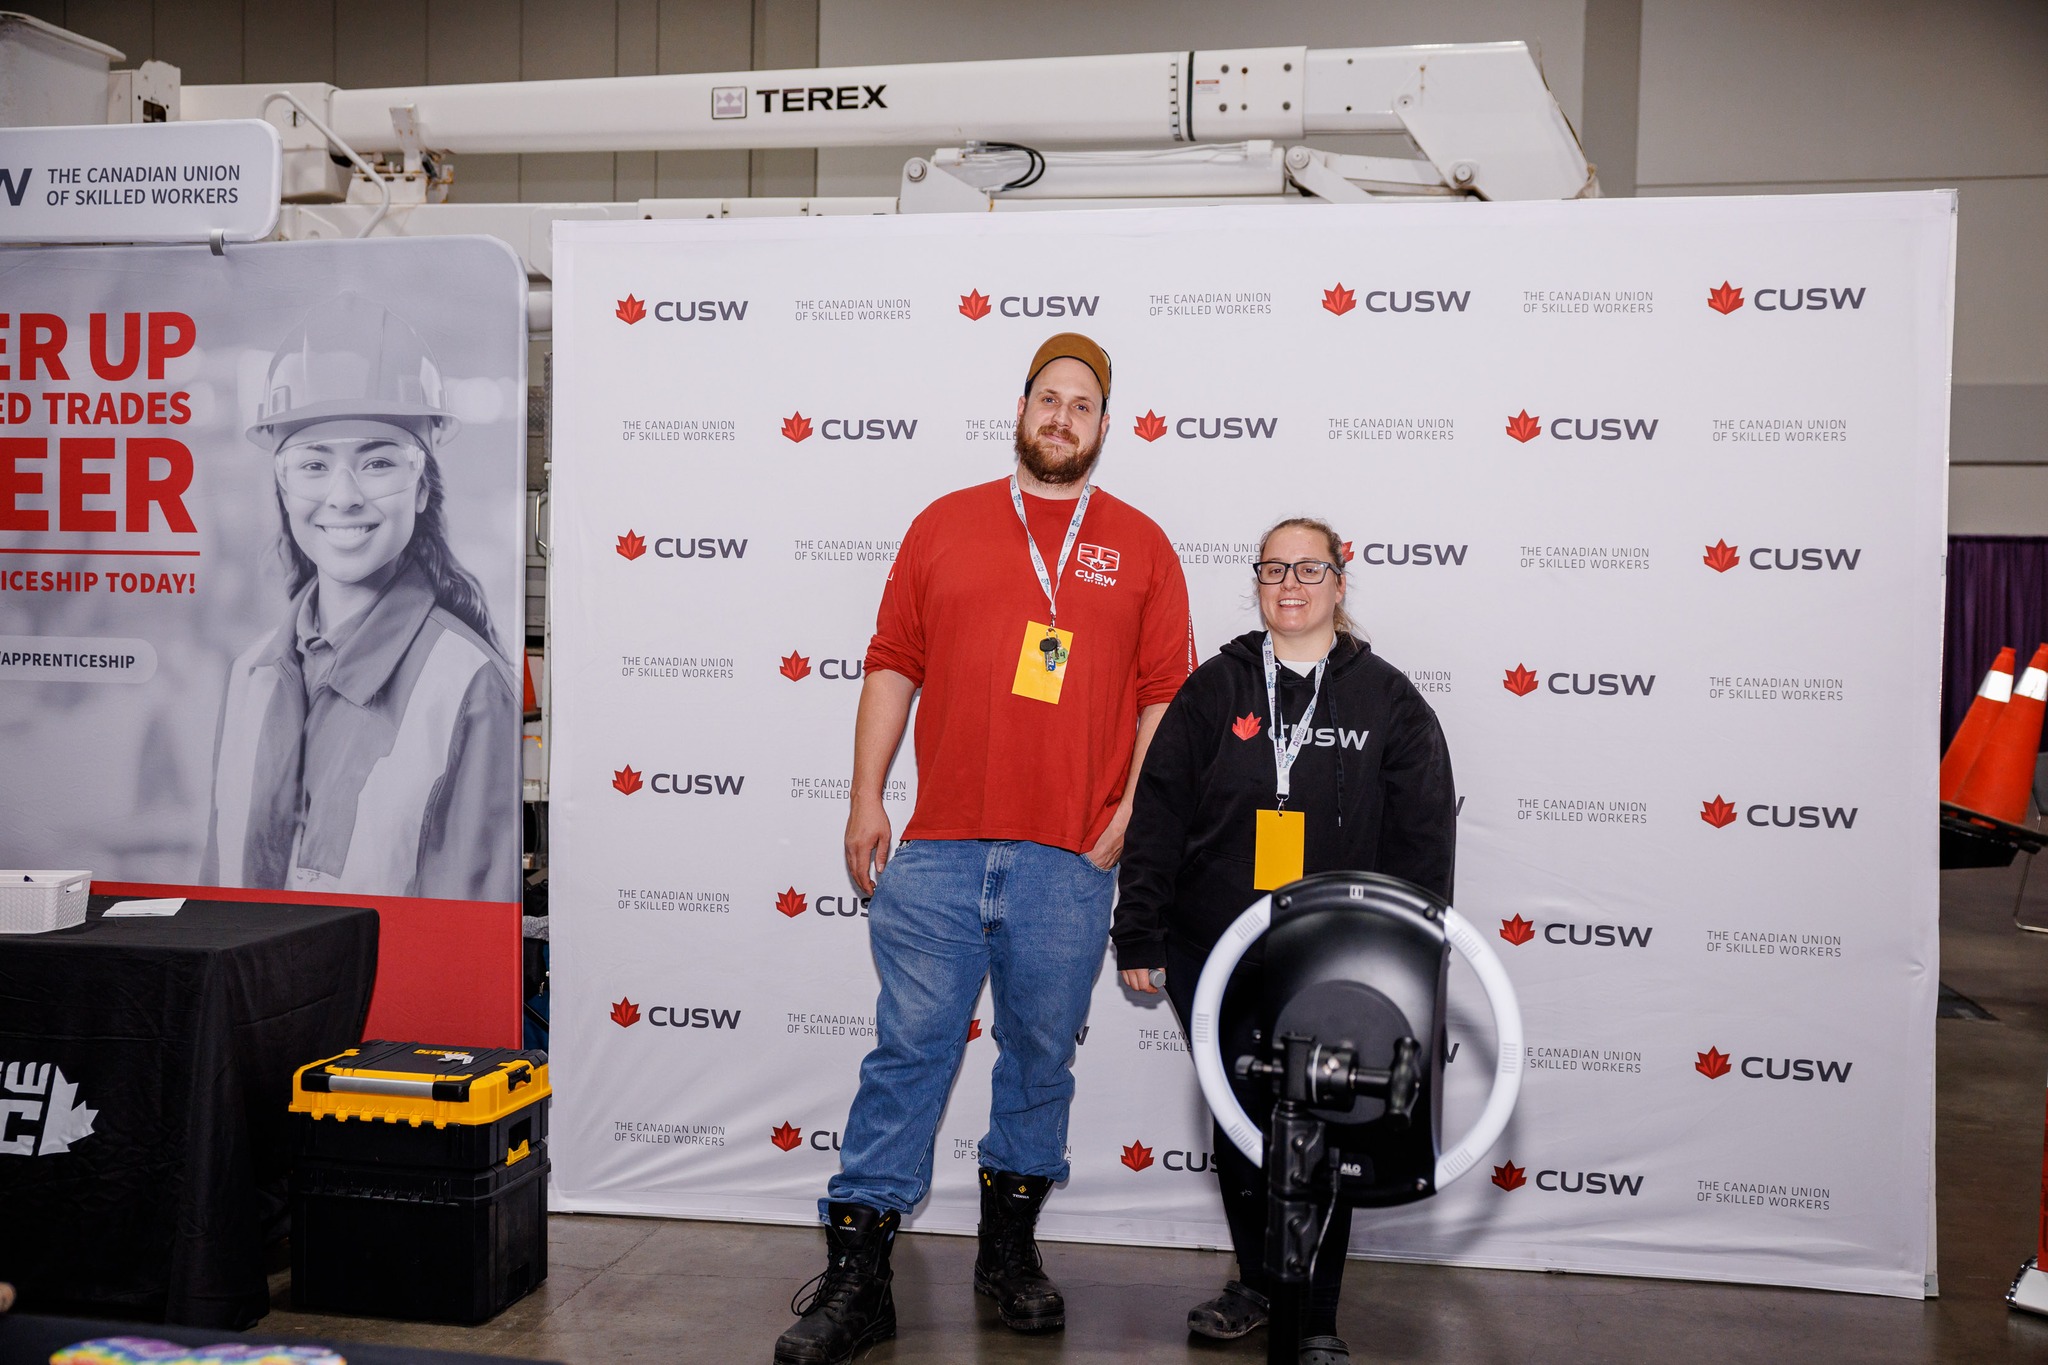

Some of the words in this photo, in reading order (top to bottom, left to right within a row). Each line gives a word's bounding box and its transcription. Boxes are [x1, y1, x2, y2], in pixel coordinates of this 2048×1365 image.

[756, 84, 888, 113] TEREX
[48, 168, 81, 184] THE
[87, 166, 177, 183] CANADIAN
[183, 165, 240, 181] UNION
[47, 190, 70, 206] OF
[75, 189, 146, 205] SKILLED
[151, 187, 239, 204] WORKERS
[1150, 295, 1170, 304] THE
[1174, 294, 1231, 304] CANADIAN
[1236, 293, 1270, 302] UNION
[1366, 291, 1470, 312] CUSW
[1524, 291, 1544, 301] THE
[1549, 292, 1610, 301] CANADIAN
[1616, 292, 1652, 301] UNION
[1755, 288, 1866, 311] CUSW
[795, 300, 814, 309] THE
[818, 300, 872, 309] CANADIAN
[877, 299, 910, 308] UNION
[1000, 296, 1099, 317] CUSW
[1150, 306, 1163, 316] OF
[1166, 305, 1211, 315] SKILLED
[1215, 304, 1271, 314] WORKERS
[1524, 303, 1539, 313] OF
[1542, 303, 1588, 313] SKILLED
[1593, 303, 1653, 313] WORKERS
[655, 301, 748, 321] CUSW
[795, 312, 808, 321] OF
[812, 311, 854, 320] SKILLED
[858, 310, 910, 320] WORKERS
[89, 312, 196, 381] UP
[42, 391, 191, 425] TRADES
[623, 421, 642, 430] THE
[645, 421, 698, 430] CANADIAN
[702, 421, 734, 430] UNION
[822, 419, 918, 440] CUSW
[966, 420, 985, 429] THE
[989, 420, 1017, 429] CANA
[1177, 418, 1278, 439] CUSW
[1329, 418, 1349, 428] THE
[1354, 418, 1412, 428] CANADIAN
[1418, 419, 1453, 428] UNION
[1551, 418, 1658, 440] CUSW
[1713, 420, 1734, 429] THE
[1740, 420, 1802, 430] CANADIAN
[1808, 420, 1846, 429] UNION
[623, 432, 635, 440] OF
[638, 432, 680, 440] SKILLED
[683, 432, 735, 440] WORKERS
[966, 431, 979, 440] OF
[983, 431, 1017, 440] SKILLE
[1329, 430, 1342, 439] OF
[1346, 430, 1392, 439] SKILLED
[1396, 430, 1454, 440] WORKERS
[1713, 432, 1727, 441] OF
[1732, 432, 1780, 441] SKILLED
[1785, 432, 1846, 441] WORKERS
[655, 538, 748, 558] CUSW
[795, 540, 813, 549] THE
[817, 540, 872, 549] CANADIAN
[876, 541, 901, 550] UNIO
[1234, 544, 1261, 553] UNIO
[795, 551, 807, 560] OF
[811, 552, 853, 560] SKILLED
[857, 552, 896, 561] WORKE
[1364, 544, 1468, 565] CUSW
[1520, 546, 1541, 556] THE
[1545, 547, 1607, 557] CANADIAN
[1612, 548, 1649, 558] UNION
[1521, 558, 1534, 567] OF
[1538, 558, 1585, 568] SKILLED
[1590, 560, 1649, 569] WORKERS
[1750, 548, 1861, 570] CUSW
[106, 573, 195, 594] TODAY!
[1075, 570, 1117, 586] CUSW
[0, 652, 135, 668] APPRENTICESHIP
[622, 656, 640, 666] THE
[644, 657, 697, 666] CANADIAN
[701, 658, 733, 667] UNION
[622, 667, 634, 676] OF
[637, 668, 678, 677] SKILLED
[682, 669, 733, 678] WORKERS
[820, 659, 862, 680] CU
[1415, 671, 1451, 681] UNION
[1413, 682, 1452, 692] RKERS
[1548, 673, 1655, 695] CUSW
[1710, 677, 1731, 687] THE
[1736, 678, 1799, 688] CANADIAN
[1804, 679, 1842, 688] UNION
[1710, 689, 1724, 698] OF
[1729, 689, 1777, 699] SKILLED
[1782, 690, 1843, 700] WORKERS
[651, 774, 744, 795] CUSW
[791, 778, 810, 787] THE
[814, 779, 850, 788] CANAD
[791, 789, 804, 798] OF
[807, 789, 850, 799] SKILLED
[1518, 799, 1538, 808] THE
[1544, 800, 1604, 810] CANADIAN
[1610, 802, 1646, 812] UNION
[1518, 810, 1532, 820] OF
[1536, 811, 1583, 821] SKILLED
[1587, 813, 1646, 824] WORKERS
[1747, 805, 1858, 829] CUSW
[618, 889, 636, 898] THE
[640, 890, 693, 900] CANADIAN
[697, 892, 729, 902] UNION
[618, 900, 630, 909] OF
[633, 901, 674, 910] SKILLED
[678, 902, 729, 913] WORKERS
[1545, 923, 1652, 947] CUSW
[1707, 930, 1729, 940] THE
[1734, 932, 1796, 943] CANADIAN
[1802, 935, 1840, 945] UNION
[1707, 942, 1722, 951] OF
[1726, 943, 1774, 954] SKILLED
[1779, 946, 1841, 957] WORKERS
[649, 1007, 741, 1029] CUSW
[787, 1013, 806, 1022] THE
[810, 1014, 864, 1025] CANADIAN
[787, 1024, 800, 1033] OF
[803, 1025, 845, 1035] SKILLED
[849, 1027, 879, 1037] WORK
[1139, 1029, 1159, 1039] THE
[1139, 1040, 1152, 1050] OF
[1537, 1047, 1599, 1059] CANADIAN
[1603, 1051, 1641, 1062] UNION
[1530, 1058, 1577, 1070] SKILLED
[1581, 1061, 1641, 1073] WORKERS
[1741, 1057, 1852, 1083] CUSW
[615, 1122, 633, 1131] THE
[637, 1123, 688, 1134] CANADIAN
[693, 1126, 725, 1135] UNION
[615, 1132, 627, 1141] OF
[630, 1132, 670, 1143] SKILLED
[674, 1135, 724, 1146] WORKERS
[954, 1138, 973, 1149] THE
[954, 1150, 967, 1159] OF
[1340, 1162, 1362, 1174] ALO
[1536, 1170, 1644, 1196] CUSW
[1698, 1180, 1719, 1191] THE
[1724, 1182, 1786, 1195] CANADIAN
[1792, 1187, 1829, 1198] UNION
[1697, 1192, 1712, 1201] OF
[1716, 1193, 1764, 1205] SKILLED
[1769, 1197, 1829, 1210] WORKERS
